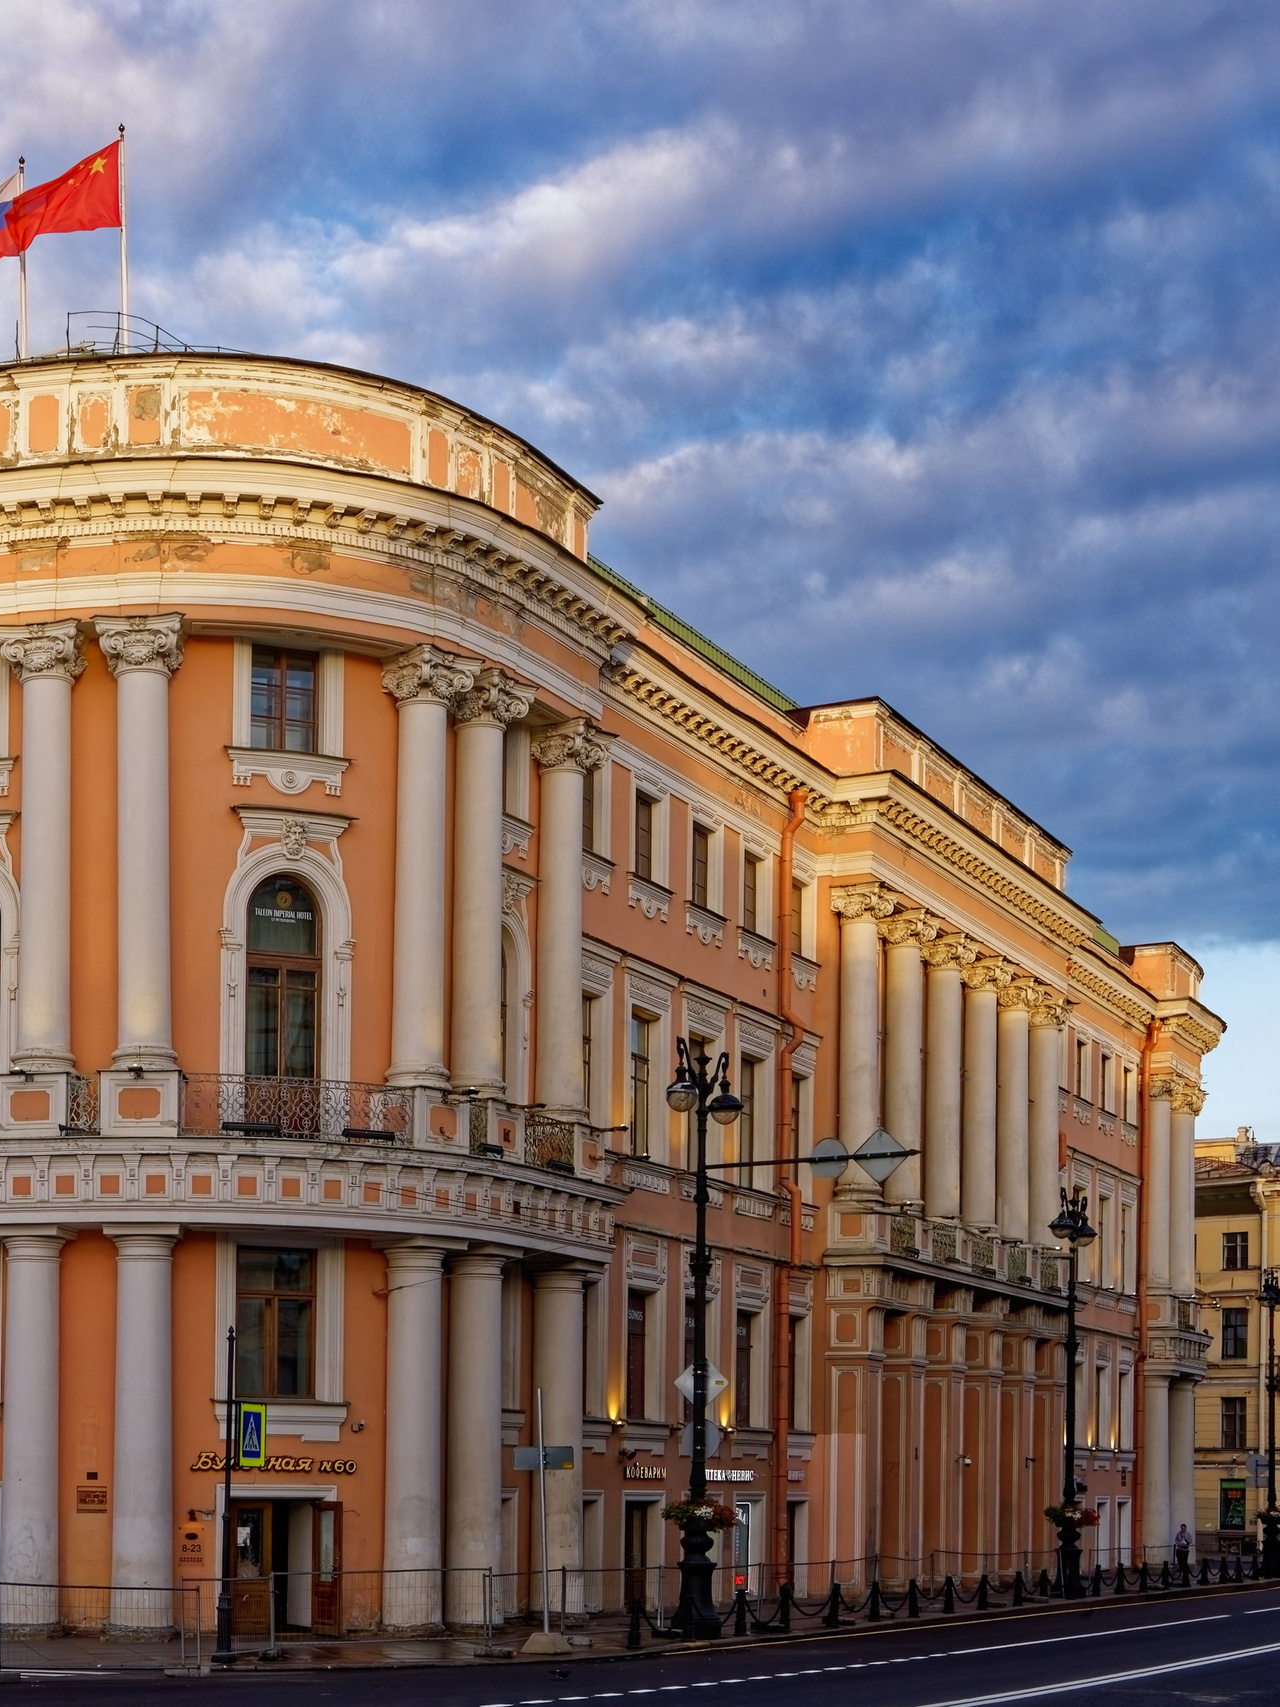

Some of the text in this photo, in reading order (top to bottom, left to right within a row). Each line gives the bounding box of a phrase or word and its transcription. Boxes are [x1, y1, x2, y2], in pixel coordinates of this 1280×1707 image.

[273, 909, 296, 919] IMPERIAL
[296, 911, 313, 921] HOTEL
[628, 1308, 643, 1321] SONGS
[626, 1464, 667, 1479] КОФЕВАРИМ
[704, 1469, 726, 1481] ПТЕКА
[181, 1544, 202, 1553] 8-23
